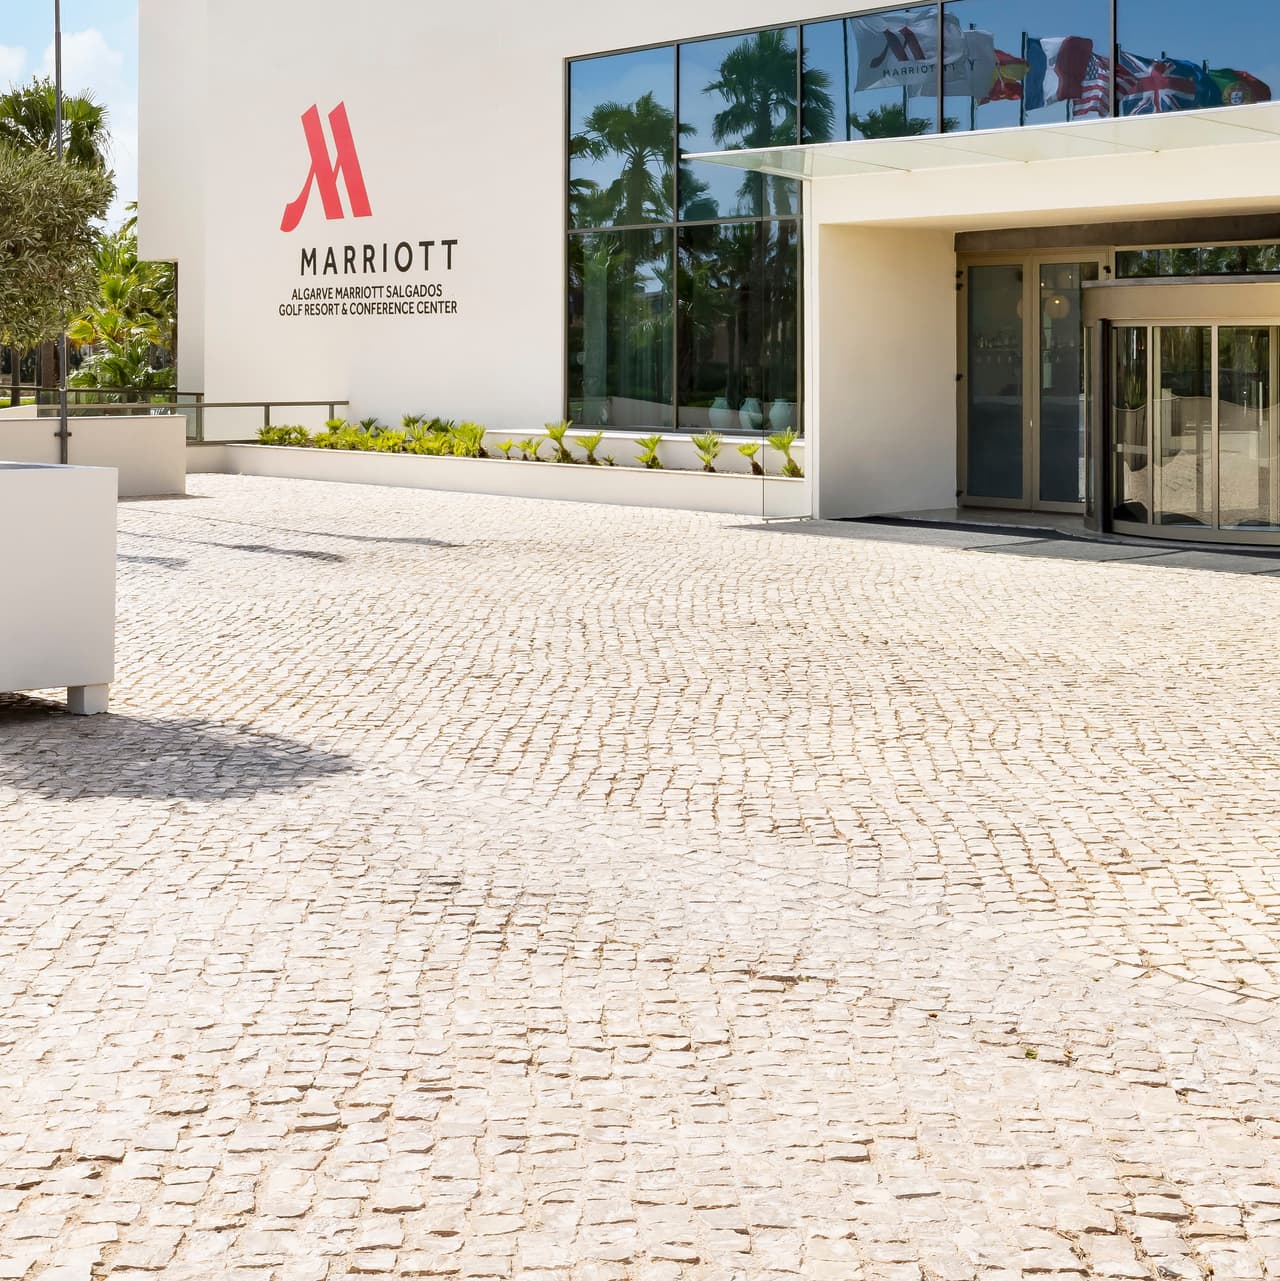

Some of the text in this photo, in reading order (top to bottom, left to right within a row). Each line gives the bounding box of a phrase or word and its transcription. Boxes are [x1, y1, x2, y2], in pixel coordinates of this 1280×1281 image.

[300, 239, 458, 276] MARRIOTT
[291, 284, 443, 300] ALGARVE MARRIOTT SALGADOS
[279, 301, 458, 316] GOLF RESORT & CONFERENCE CENTER
